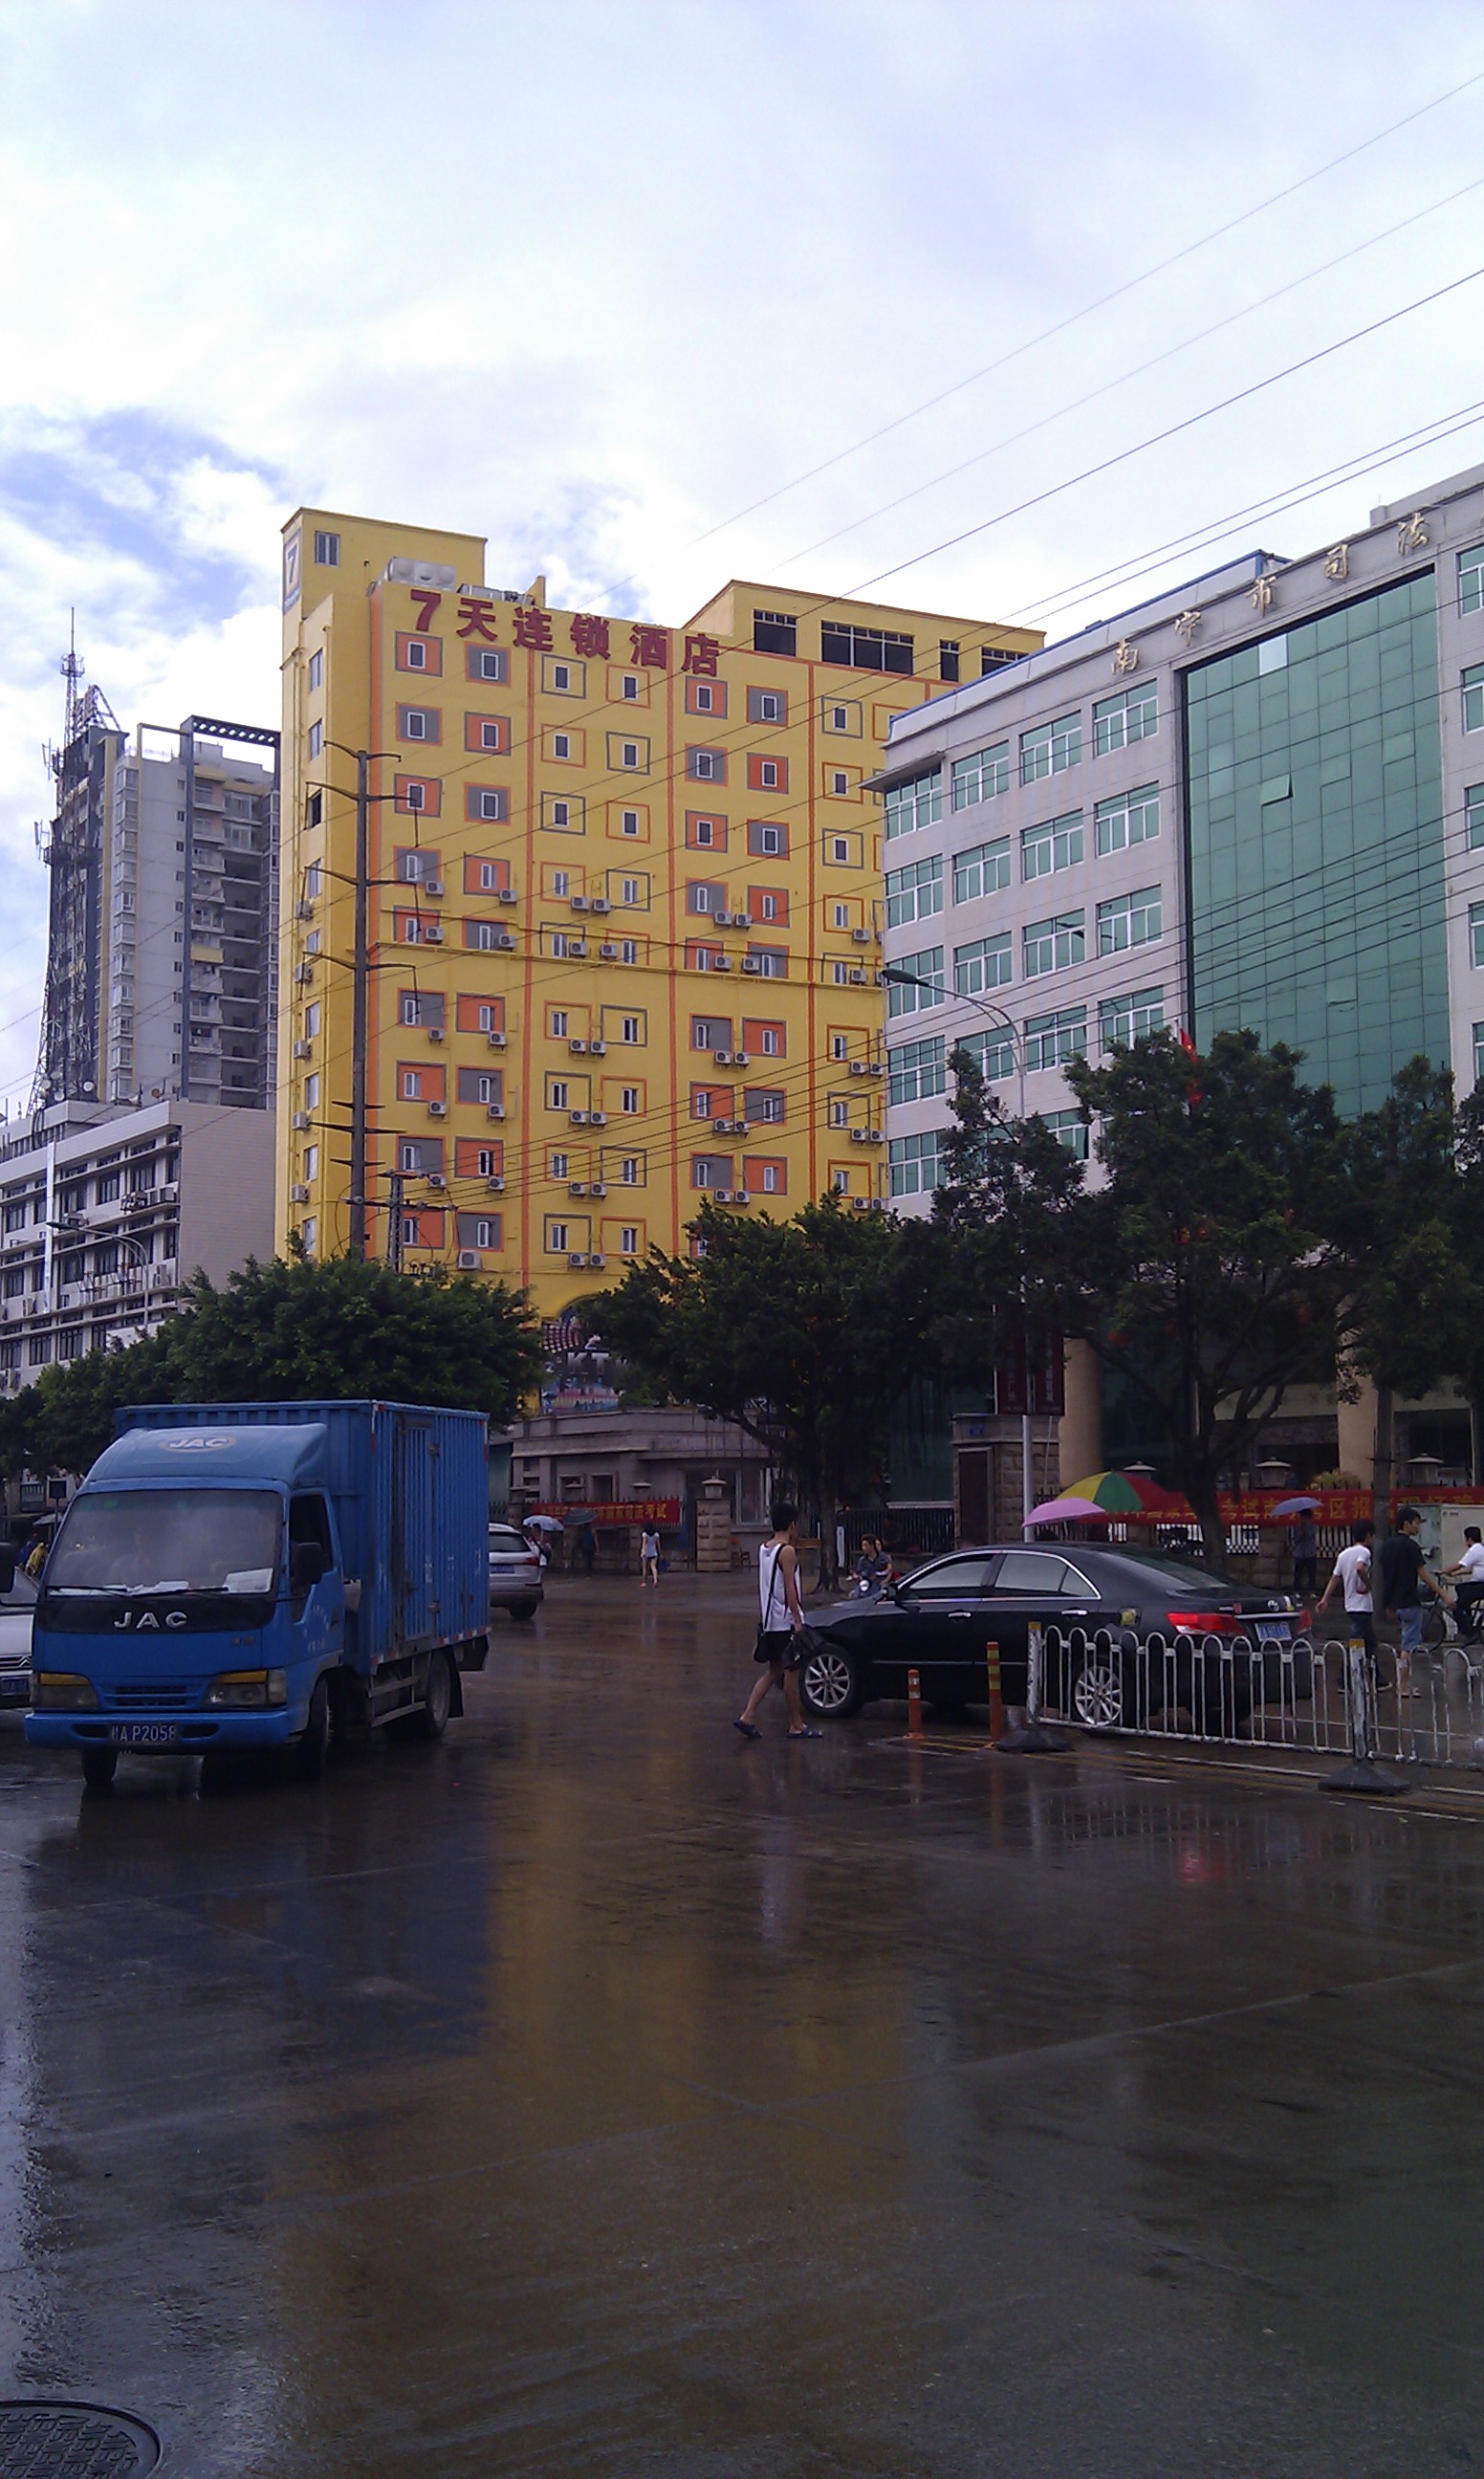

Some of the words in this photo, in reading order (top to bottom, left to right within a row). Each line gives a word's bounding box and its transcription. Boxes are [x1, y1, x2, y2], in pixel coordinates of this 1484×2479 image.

[410, 589, 719, 676] 7天连锁酒店
[169, 1437, 229, 1449] JAC
[113, 1611, 188, 1630] JAC
